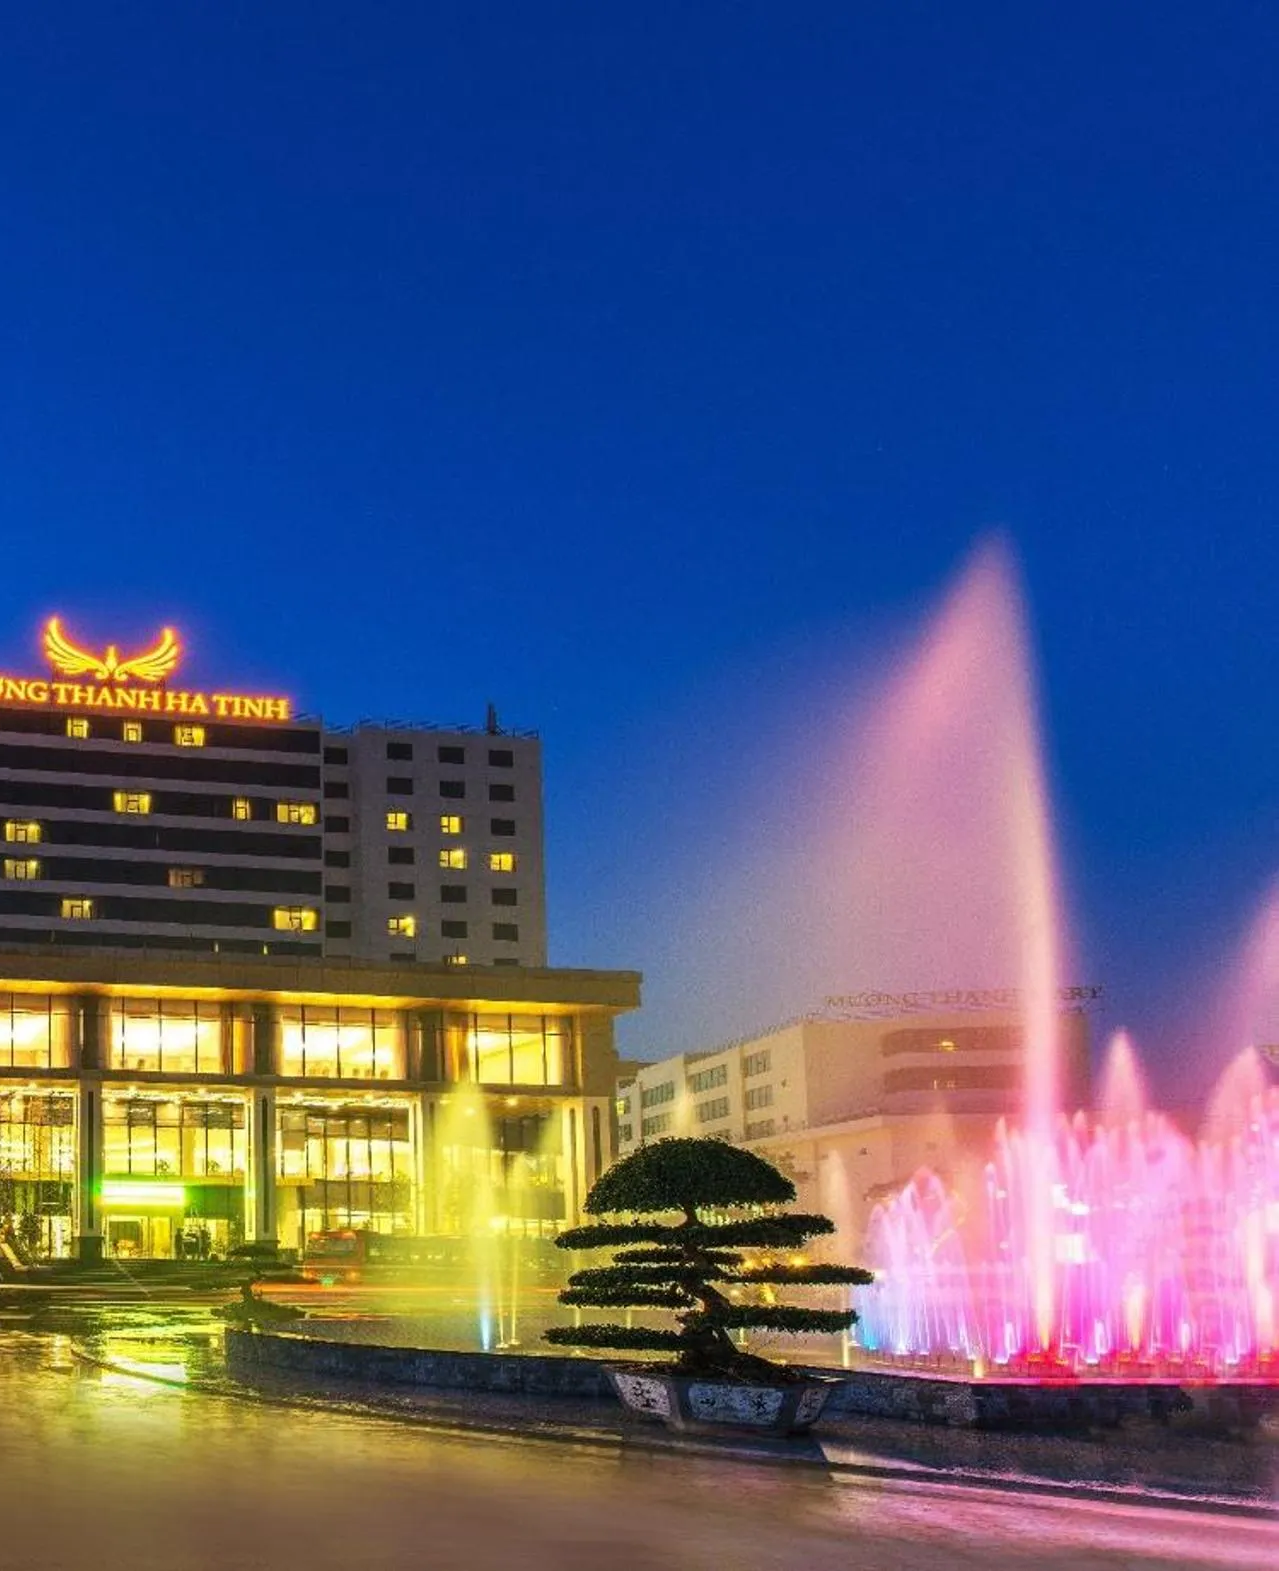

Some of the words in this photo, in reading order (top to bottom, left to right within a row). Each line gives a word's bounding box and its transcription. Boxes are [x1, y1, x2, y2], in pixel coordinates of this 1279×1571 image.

[51, 682, 160, 711] THANH
[166, 691, 209, 715] HA
[212, 693, 290, 720] TINH
